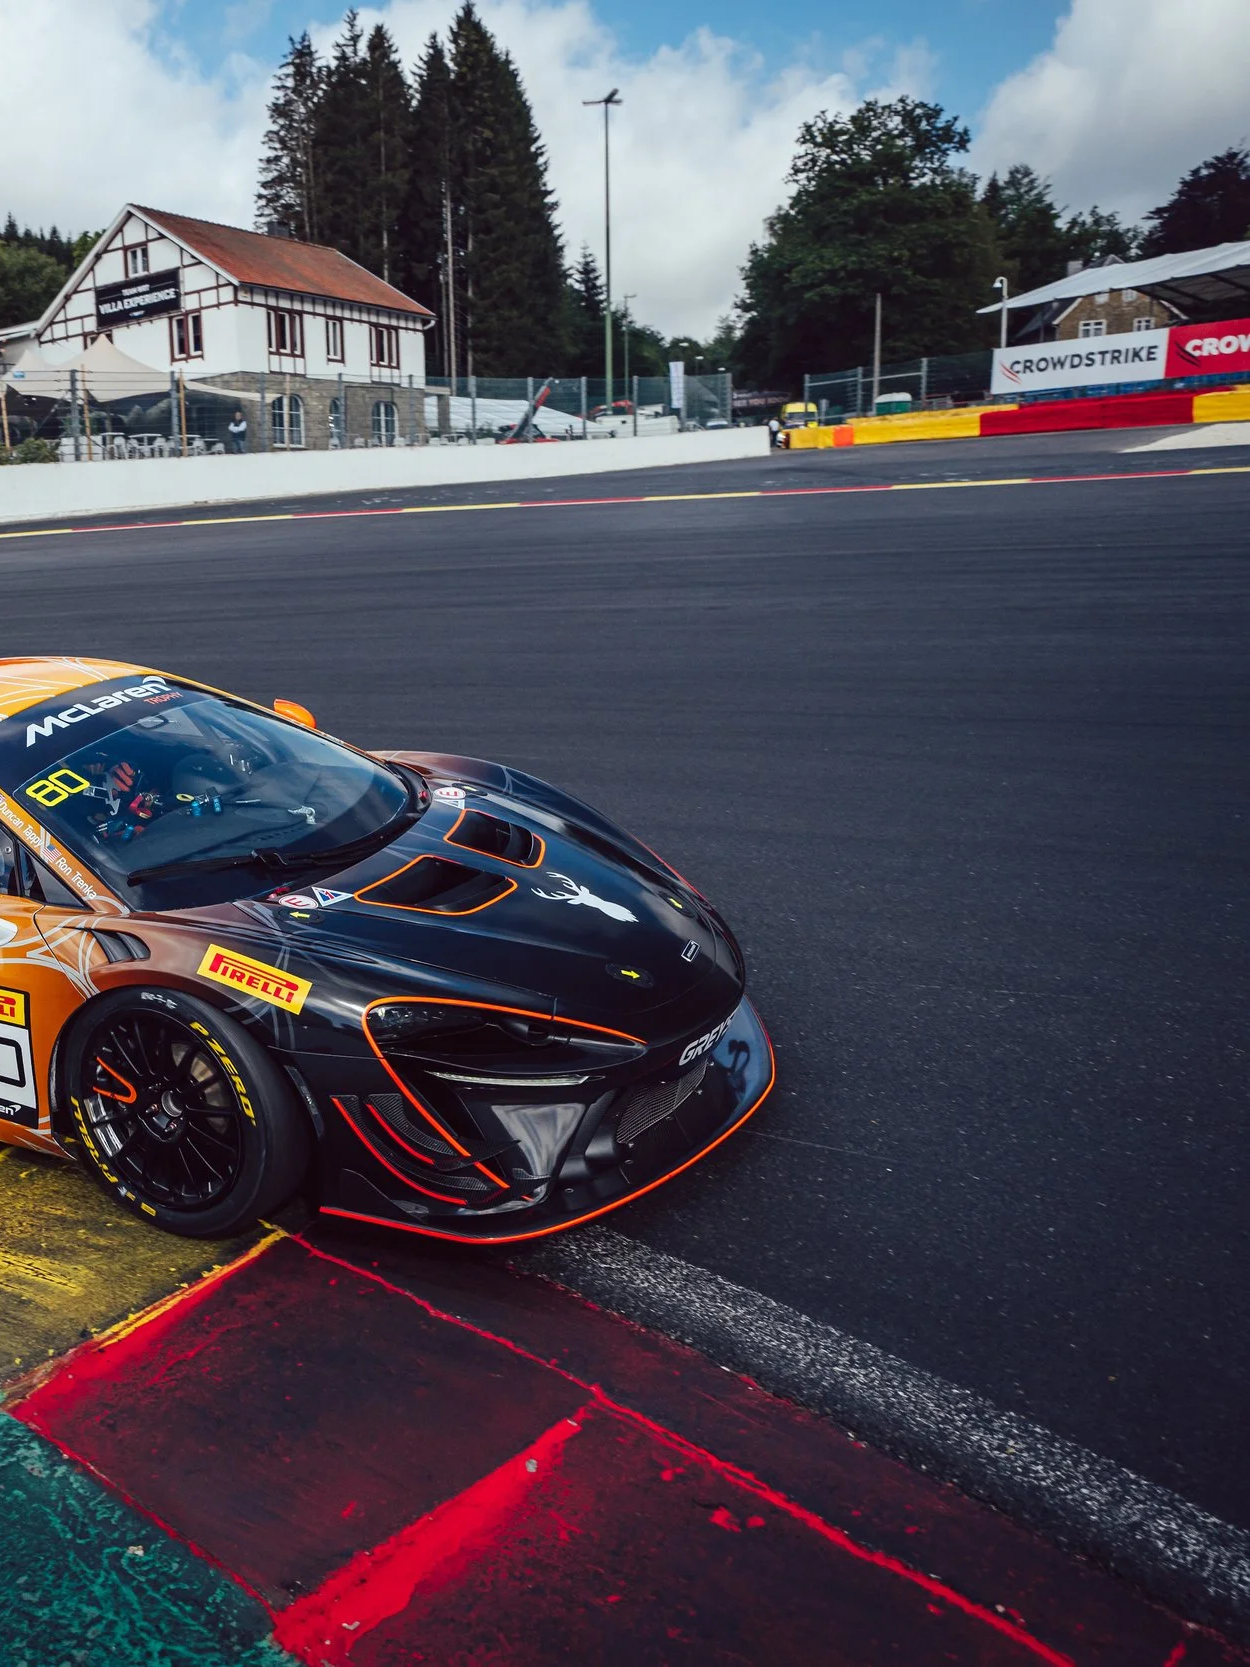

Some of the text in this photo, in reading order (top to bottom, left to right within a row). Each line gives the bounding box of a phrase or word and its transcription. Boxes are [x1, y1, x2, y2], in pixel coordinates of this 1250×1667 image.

[98, 287, 177, 315] VILLA EXPERIENCE
[1010, 345, 1159, 374] CROWDSTRIKE
[26, 676, 172, 748] McLaren
[143, 691, 184, 705] TROPHY
[25, 768, 91, 807] 80
[22, 824, 44, 848] Tappy
[55, 856, 98, 900] Ron Trenka
[208, 952, 299, 1004] PIRELLI
